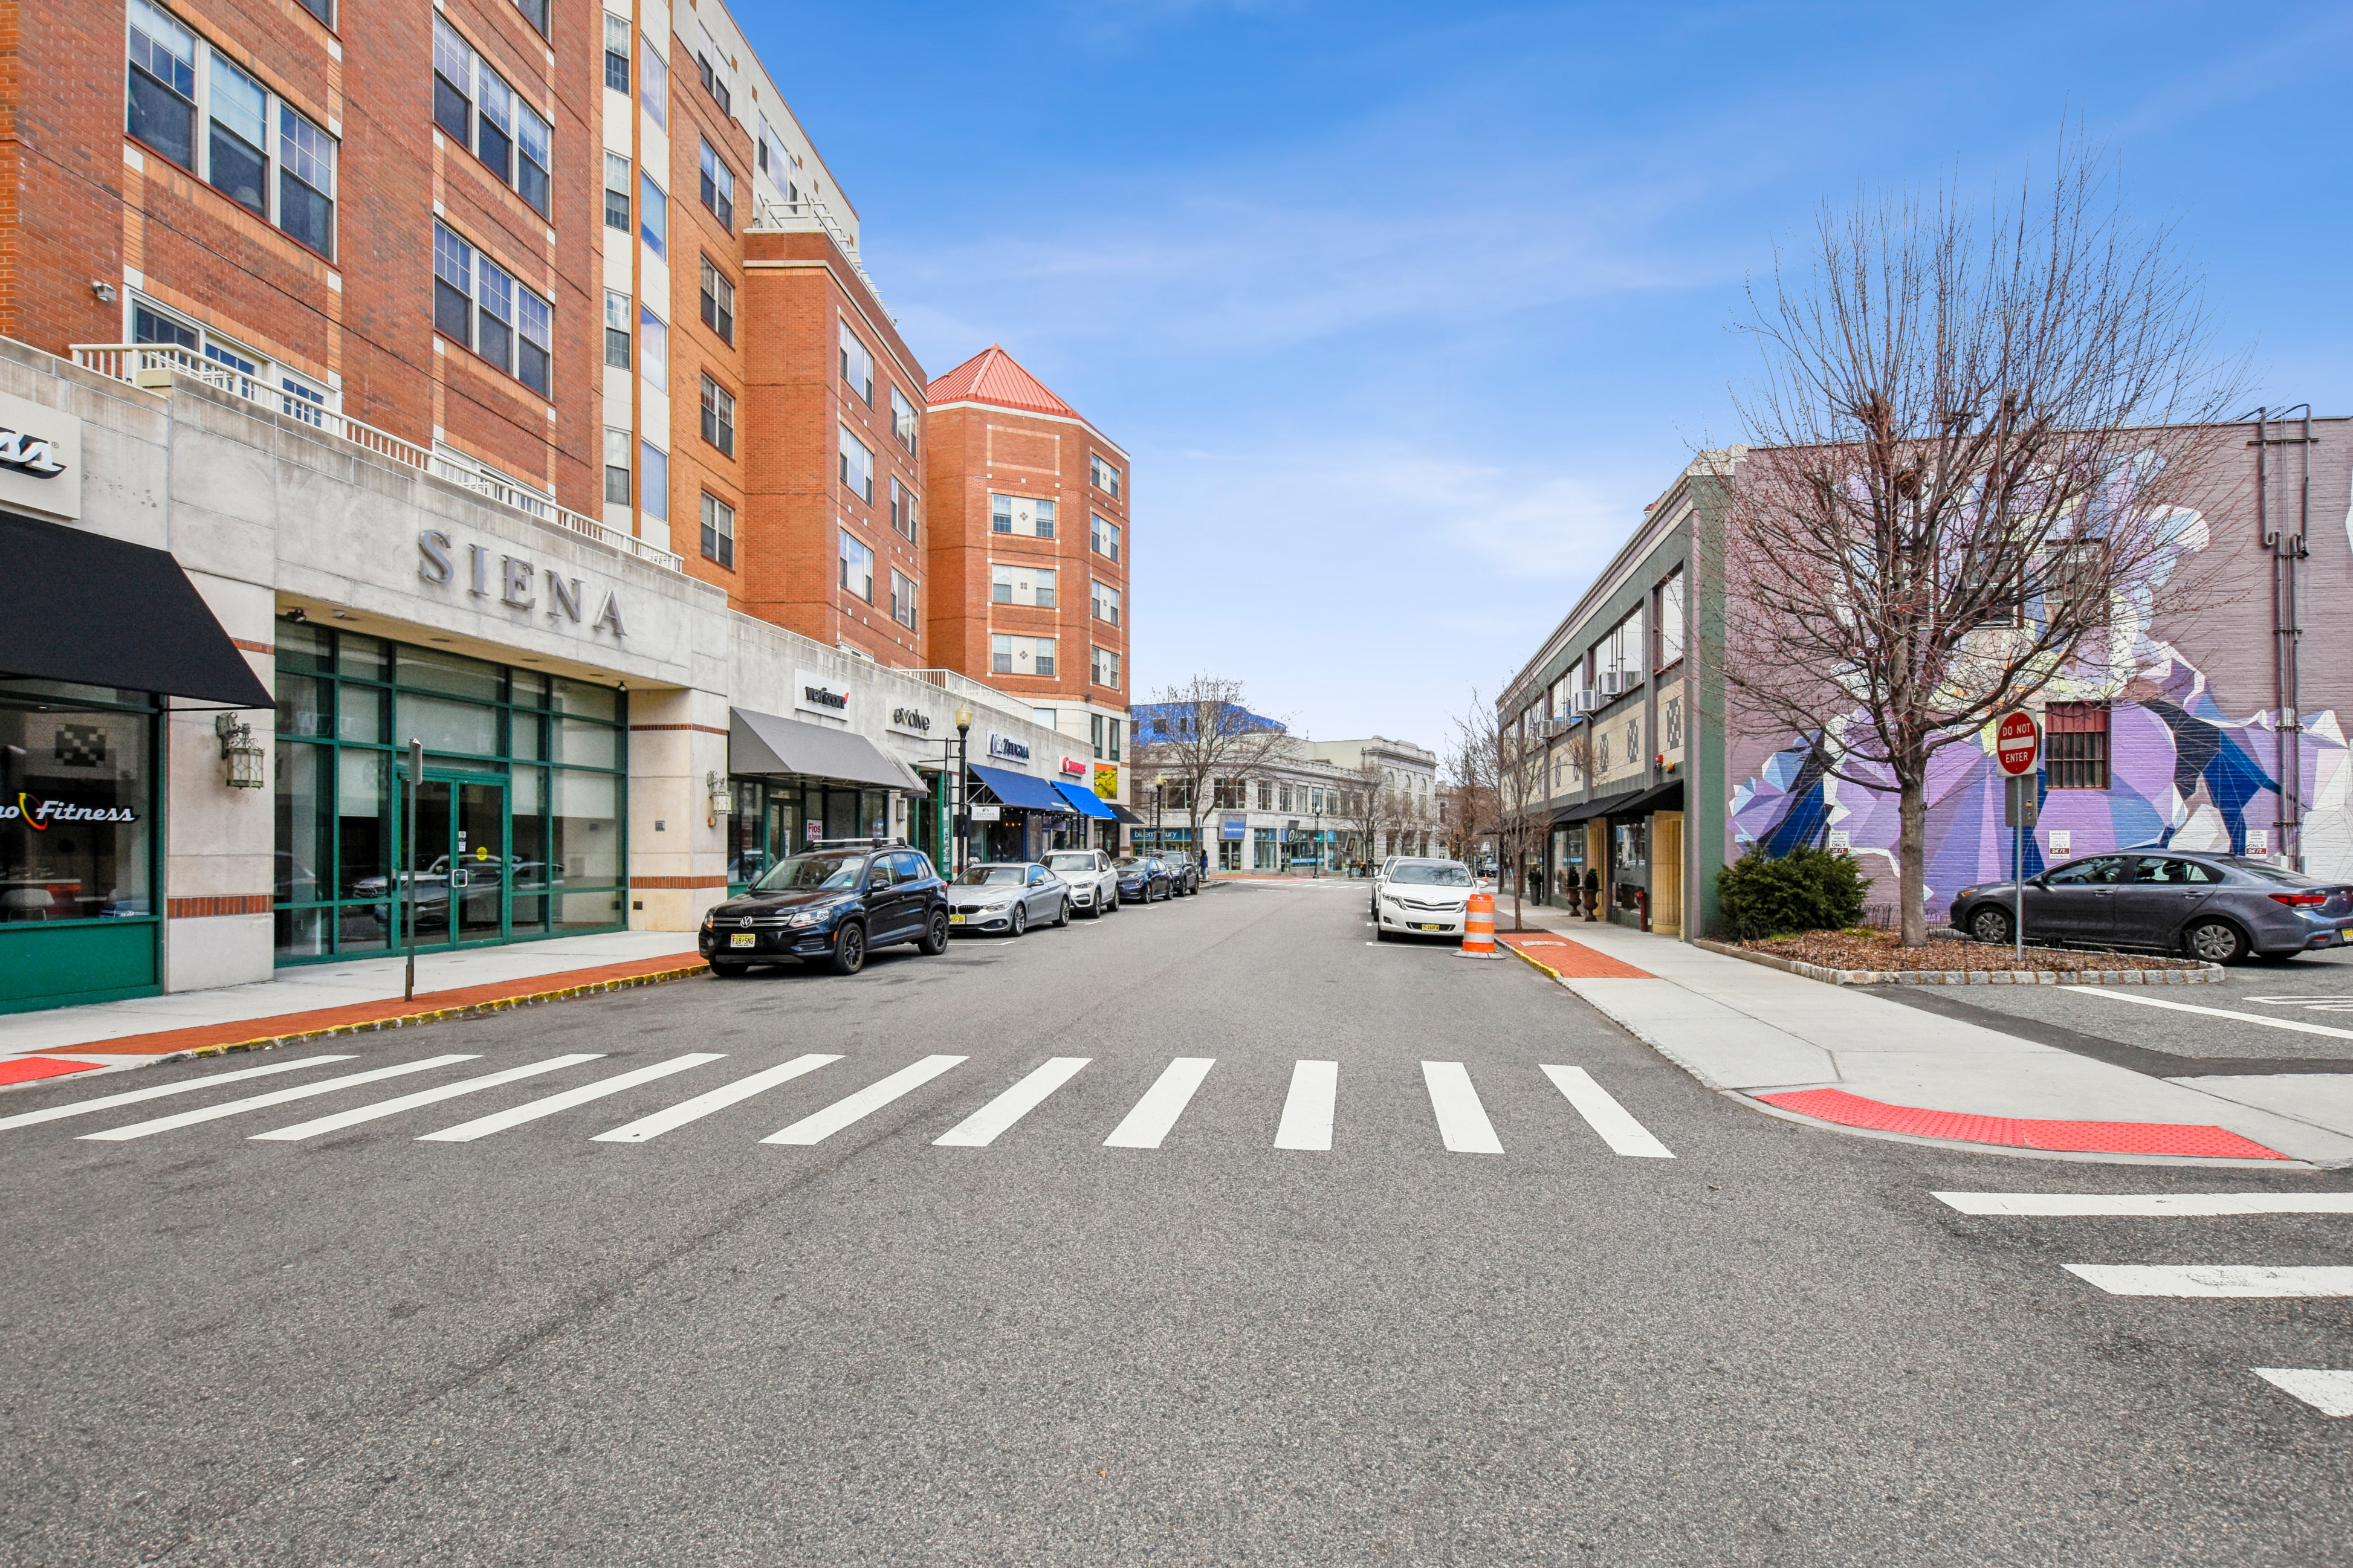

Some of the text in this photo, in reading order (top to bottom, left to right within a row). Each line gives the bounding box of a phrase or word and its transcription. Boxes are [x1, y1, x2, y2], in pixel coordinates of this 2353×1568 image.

[419, 528, 628, 636] SIENA
[804, 686, 845, 709] verizon
[893, 708, 930, 731] evolve
[2002, 723, 2031, 736] DO NOT
[2005, 751, 2028, 763] ENTER
[36, 801, 135, 821] Fitness
[808, 823, 821, 833] Fios
